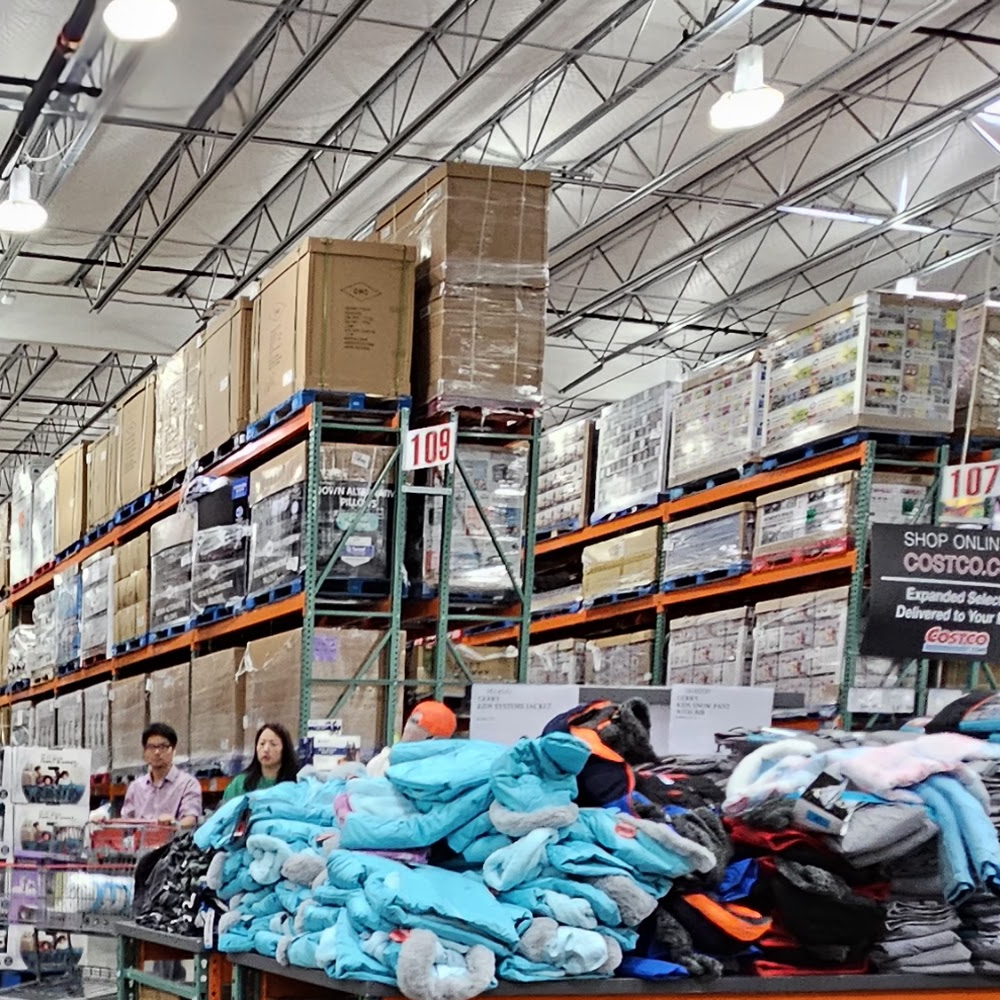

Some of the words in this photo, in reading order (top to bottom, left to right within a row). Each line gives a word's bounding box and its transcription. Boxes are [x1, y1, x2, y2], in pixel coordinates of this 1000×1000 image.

[411, 428, 450, 466] 109
[951, 465, 1000, 498] 107
[904, 531, 949, 549] SHOP
[953, 534, 1000, 551] ONLIN
[905, 586, 966, 604] Expanded
[895, 604, 952, 622] Delivered
[953, 609, 966, 623] to
[968, 609, 996, 624] Your
[925, 626, 989, 646] COSTCO
